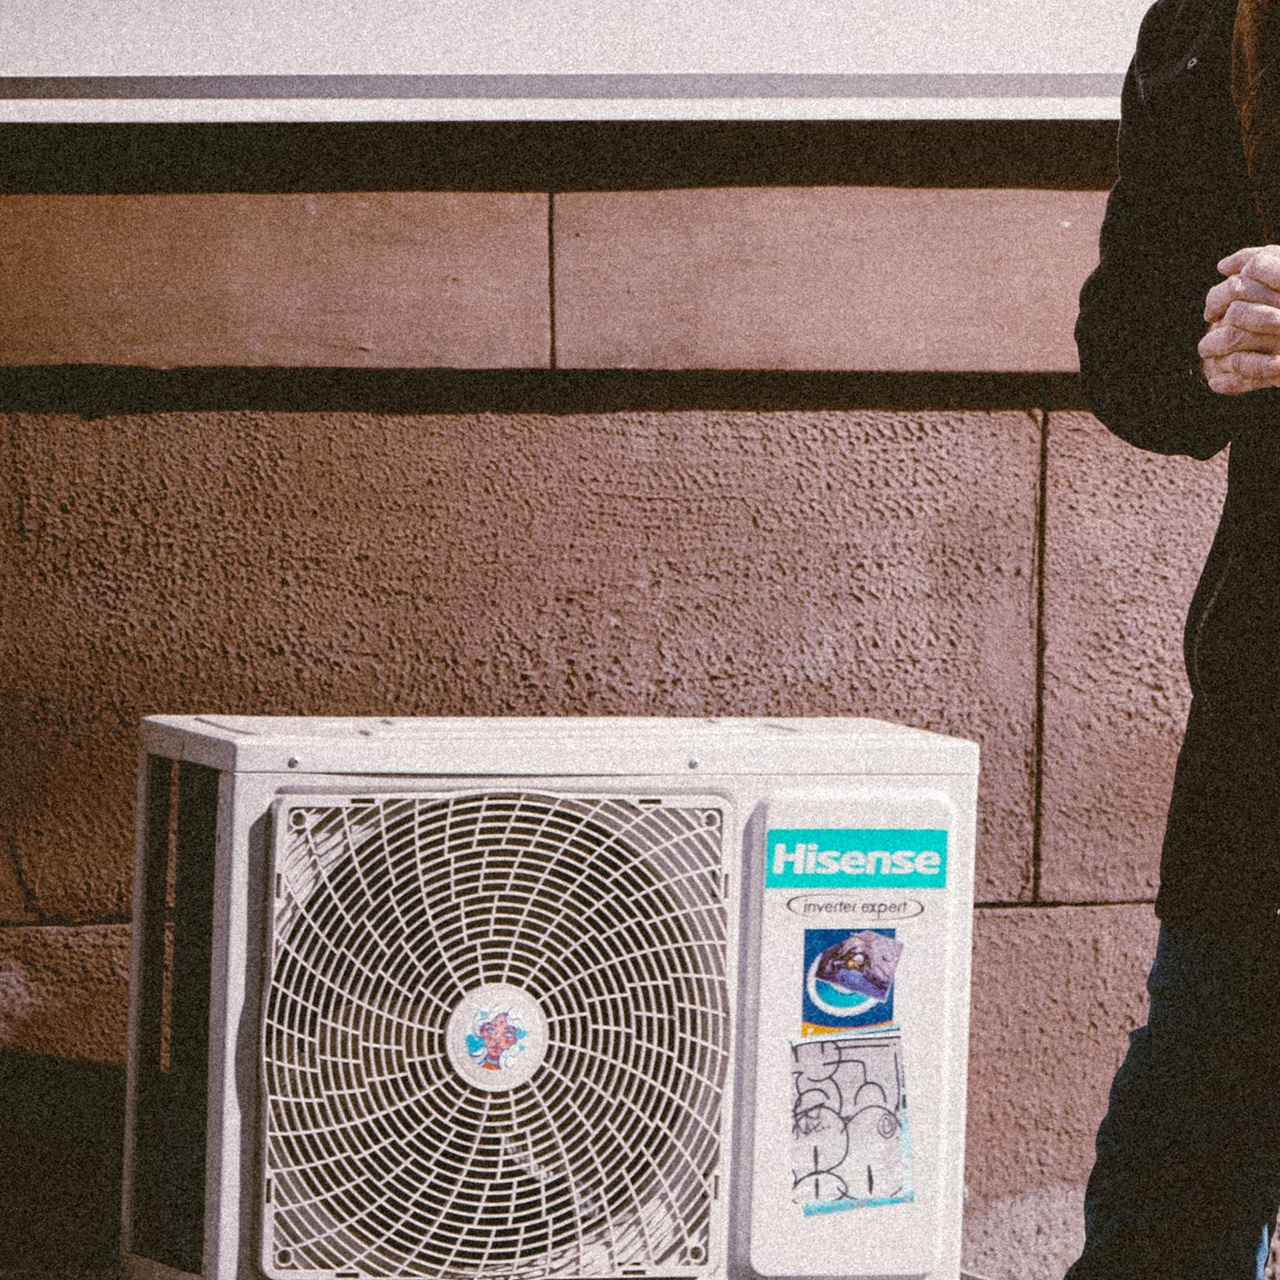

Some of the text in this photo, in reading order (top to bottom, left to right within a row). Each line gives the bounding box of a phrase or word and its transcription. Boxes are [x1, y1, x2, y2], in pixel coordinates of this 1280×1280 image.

[772, 843, 941, 875] Hisense
[803, 899, 907, 918] inverter expert
